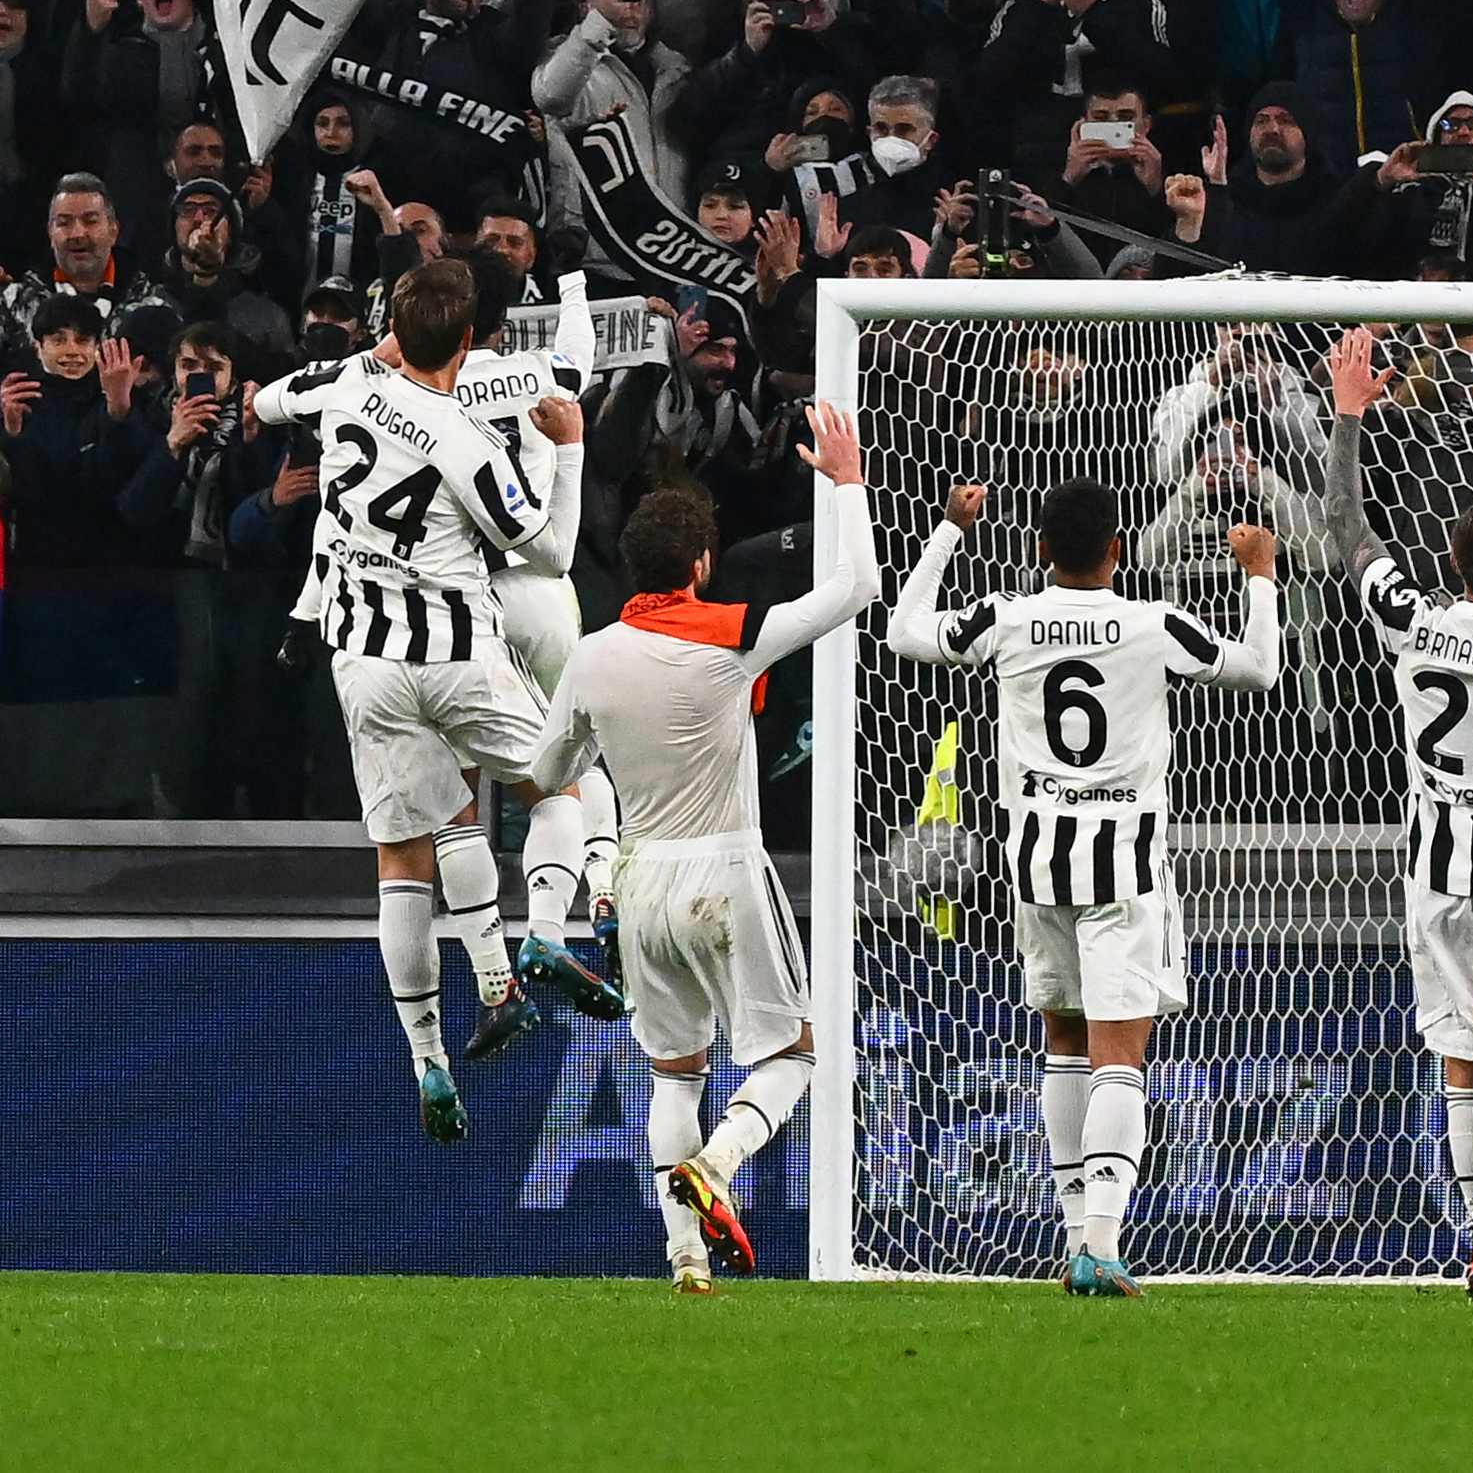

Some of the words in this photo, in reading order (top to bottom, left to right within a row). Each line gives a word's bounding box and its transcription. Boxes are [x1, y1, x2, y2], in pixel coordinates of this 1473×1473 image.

[330, 55, 431, 109] ALLA
[434, 91, 527, 144] FINE
[591, 308, 658, 357] FINE
[360, 392, 438, 456] RUGANI
[325, 422, 444, 562] 24
[1031, 619, 1122, 646] DANILO
[1042, 659, 1108, 768] 6
[1042, 777, 1138, 806] Cygames
